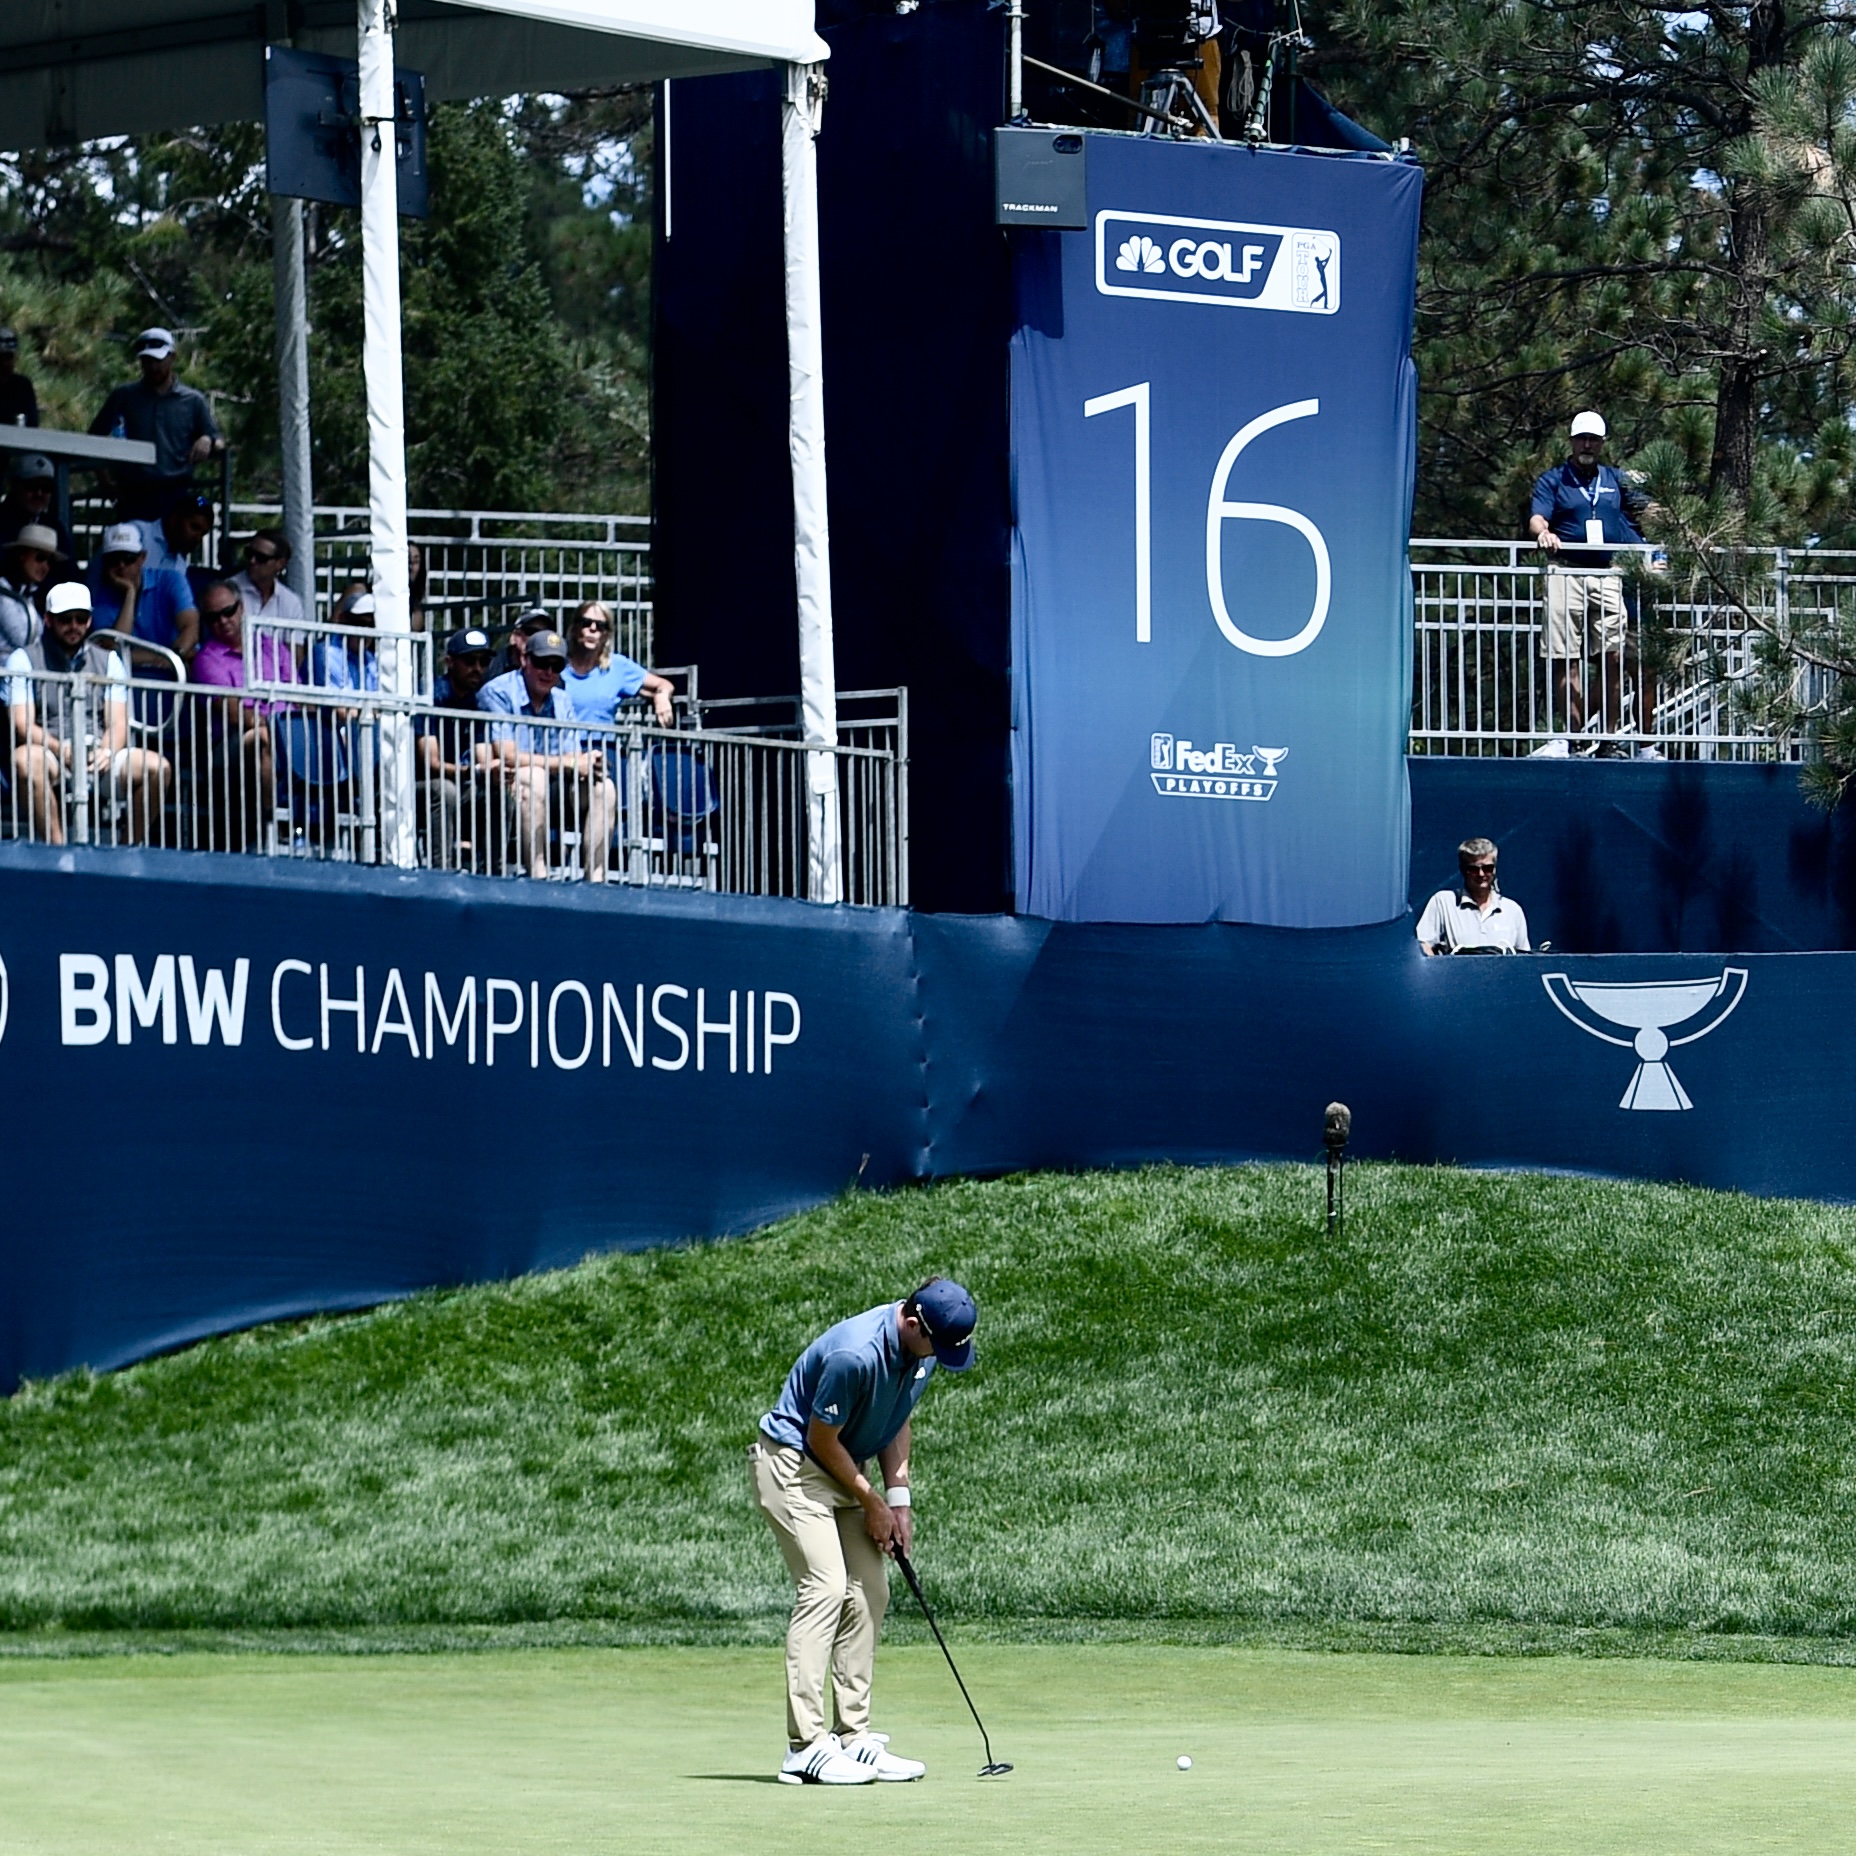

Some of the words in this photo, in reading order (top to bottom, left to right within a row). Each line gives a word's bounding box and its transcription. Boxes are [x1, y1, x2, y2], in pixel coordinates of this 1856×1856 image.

[1002, 203, 1059, 213] TRACKMAN
[1168, 238, 1265, 283] GOLF
[1296, 241, 1317, 251] PGA
[1295, 250, 1310, 303] TOUR
[1084, 381, 1332, 658] 16
[1175, 740, 1256, 776] FedEx
[1165, 777, 1264, 797] PLAYOFFS
[59, 953, 250, 1047] BMW
[271, 958, 802, 1076] CHAMPIONSHIP
